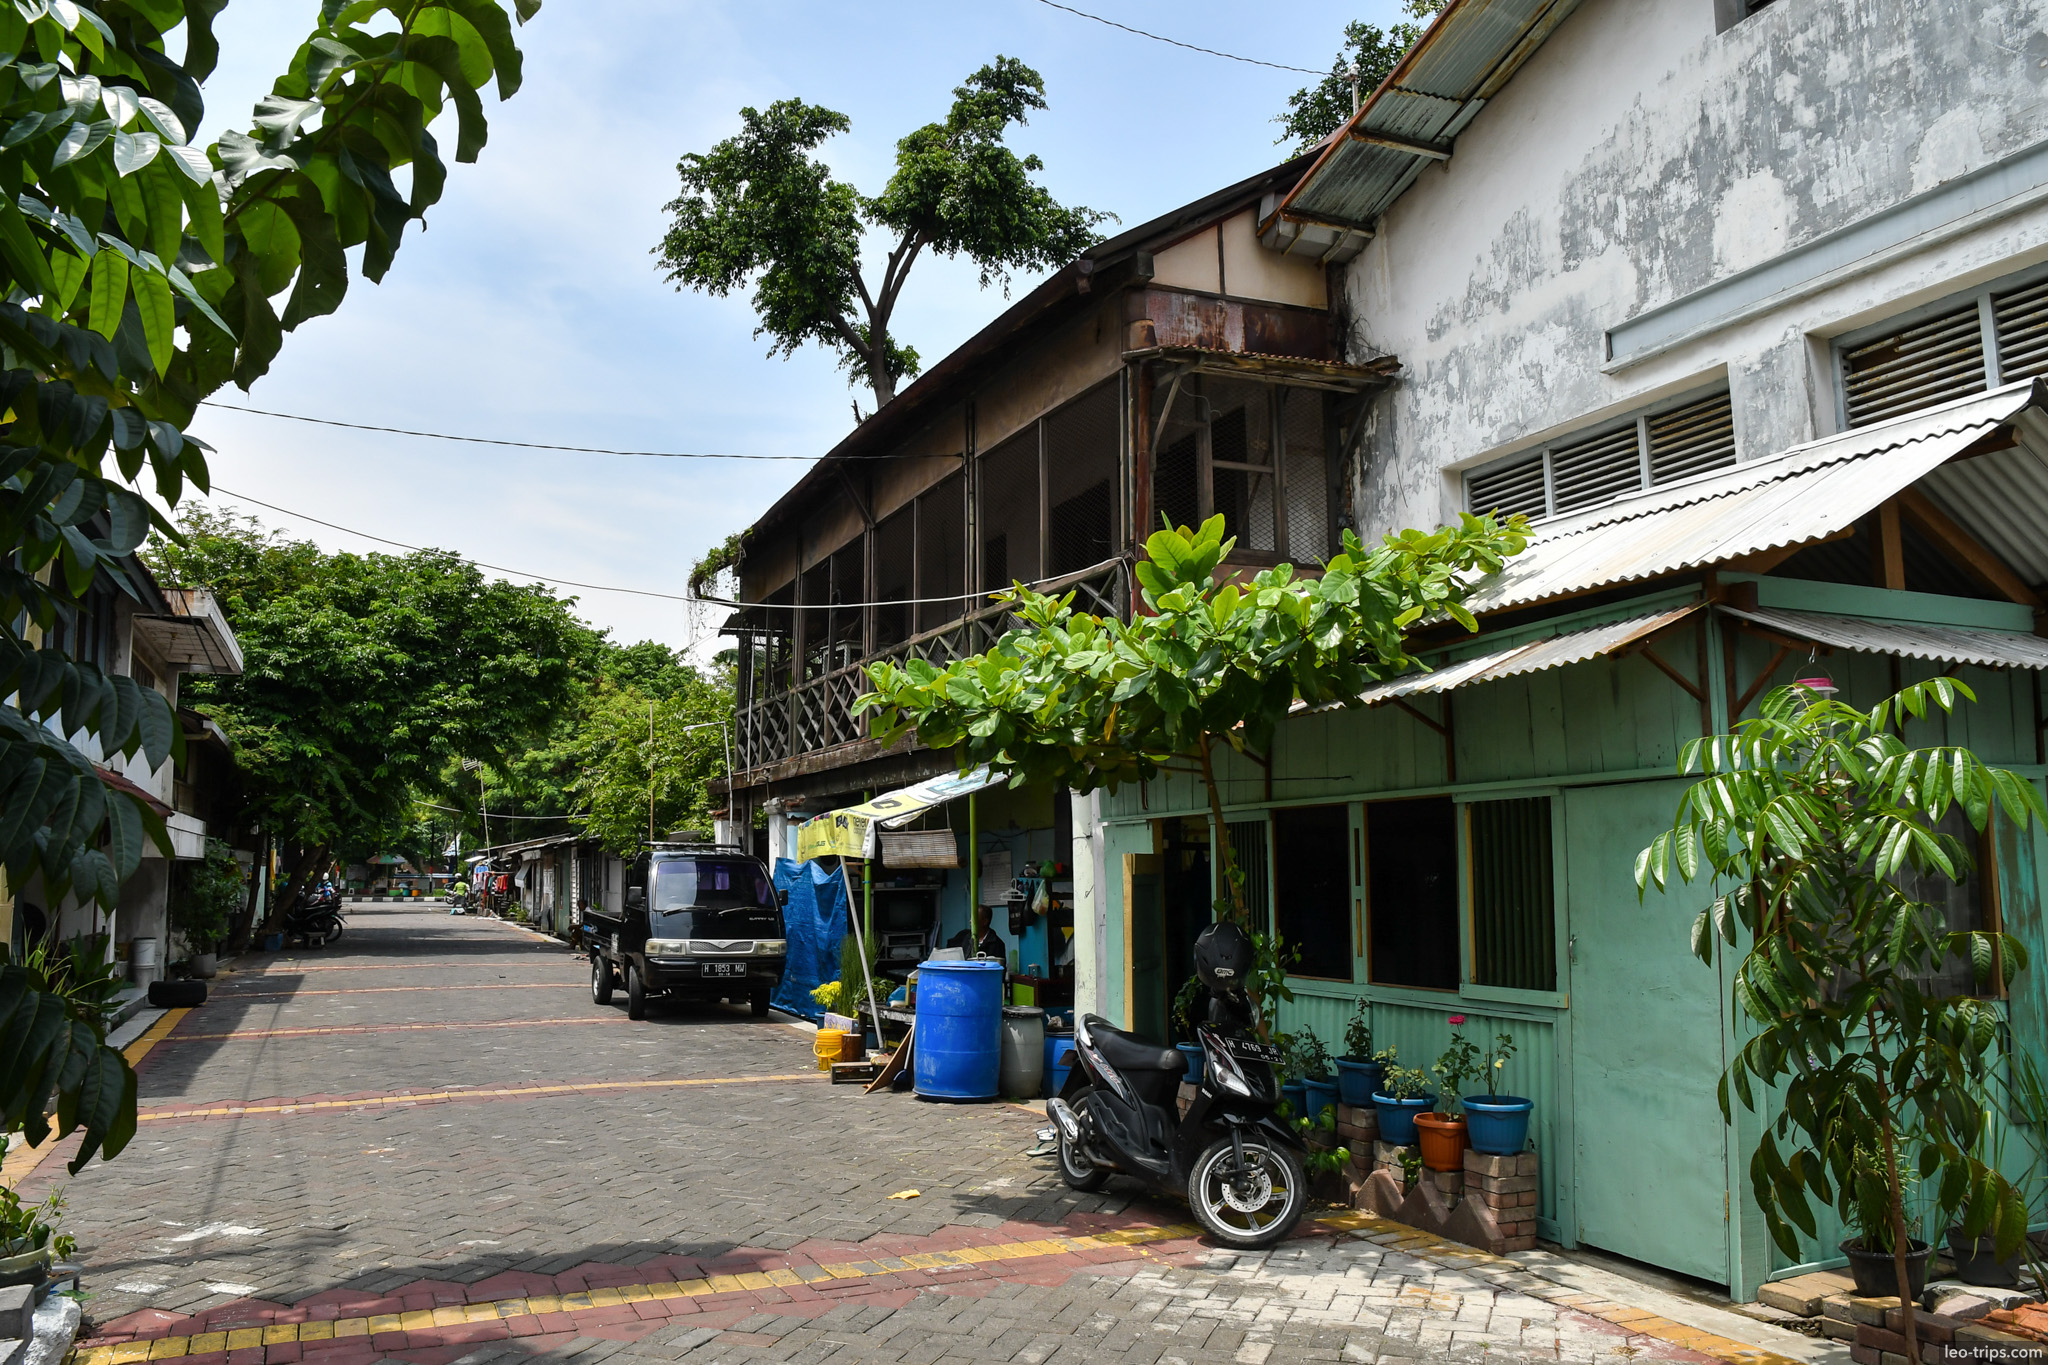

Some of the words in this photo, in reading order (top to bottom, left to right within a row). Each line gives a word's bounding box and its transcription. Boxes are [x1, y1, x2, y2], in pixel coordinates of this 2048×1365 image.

[704, 964, 709, 973] H
[714, 964, 730, 973] 1853
[734, 964, 745, 973] MW
[1227, 1039, 1236, 1049] H
[1241, 1041, 1262, 1053] 4769
[1268, 1046, 1279, 1056] JR
